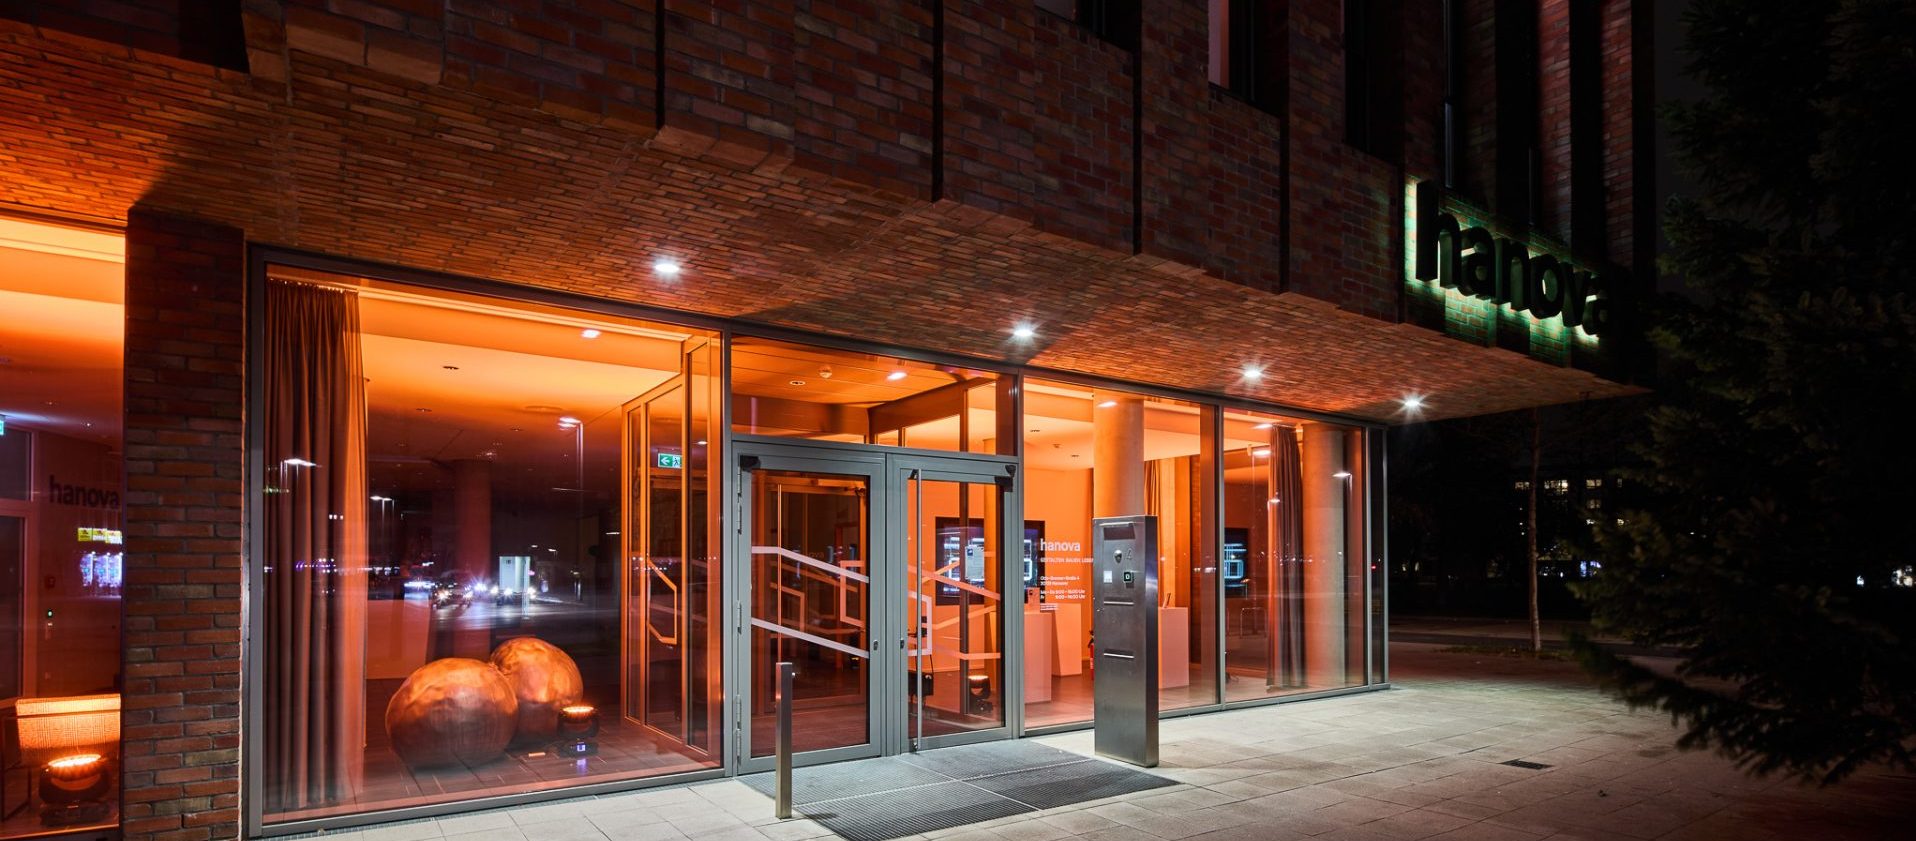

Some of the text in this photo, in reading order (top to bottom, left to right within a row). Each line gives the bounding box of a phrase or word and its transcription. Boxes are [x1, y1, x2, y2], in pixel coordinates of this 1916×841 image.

[1416, 181, 1610, 336] hanova
[50, 475, 119, 509] hanova
[1040, 538, 1080, 551] hanova
